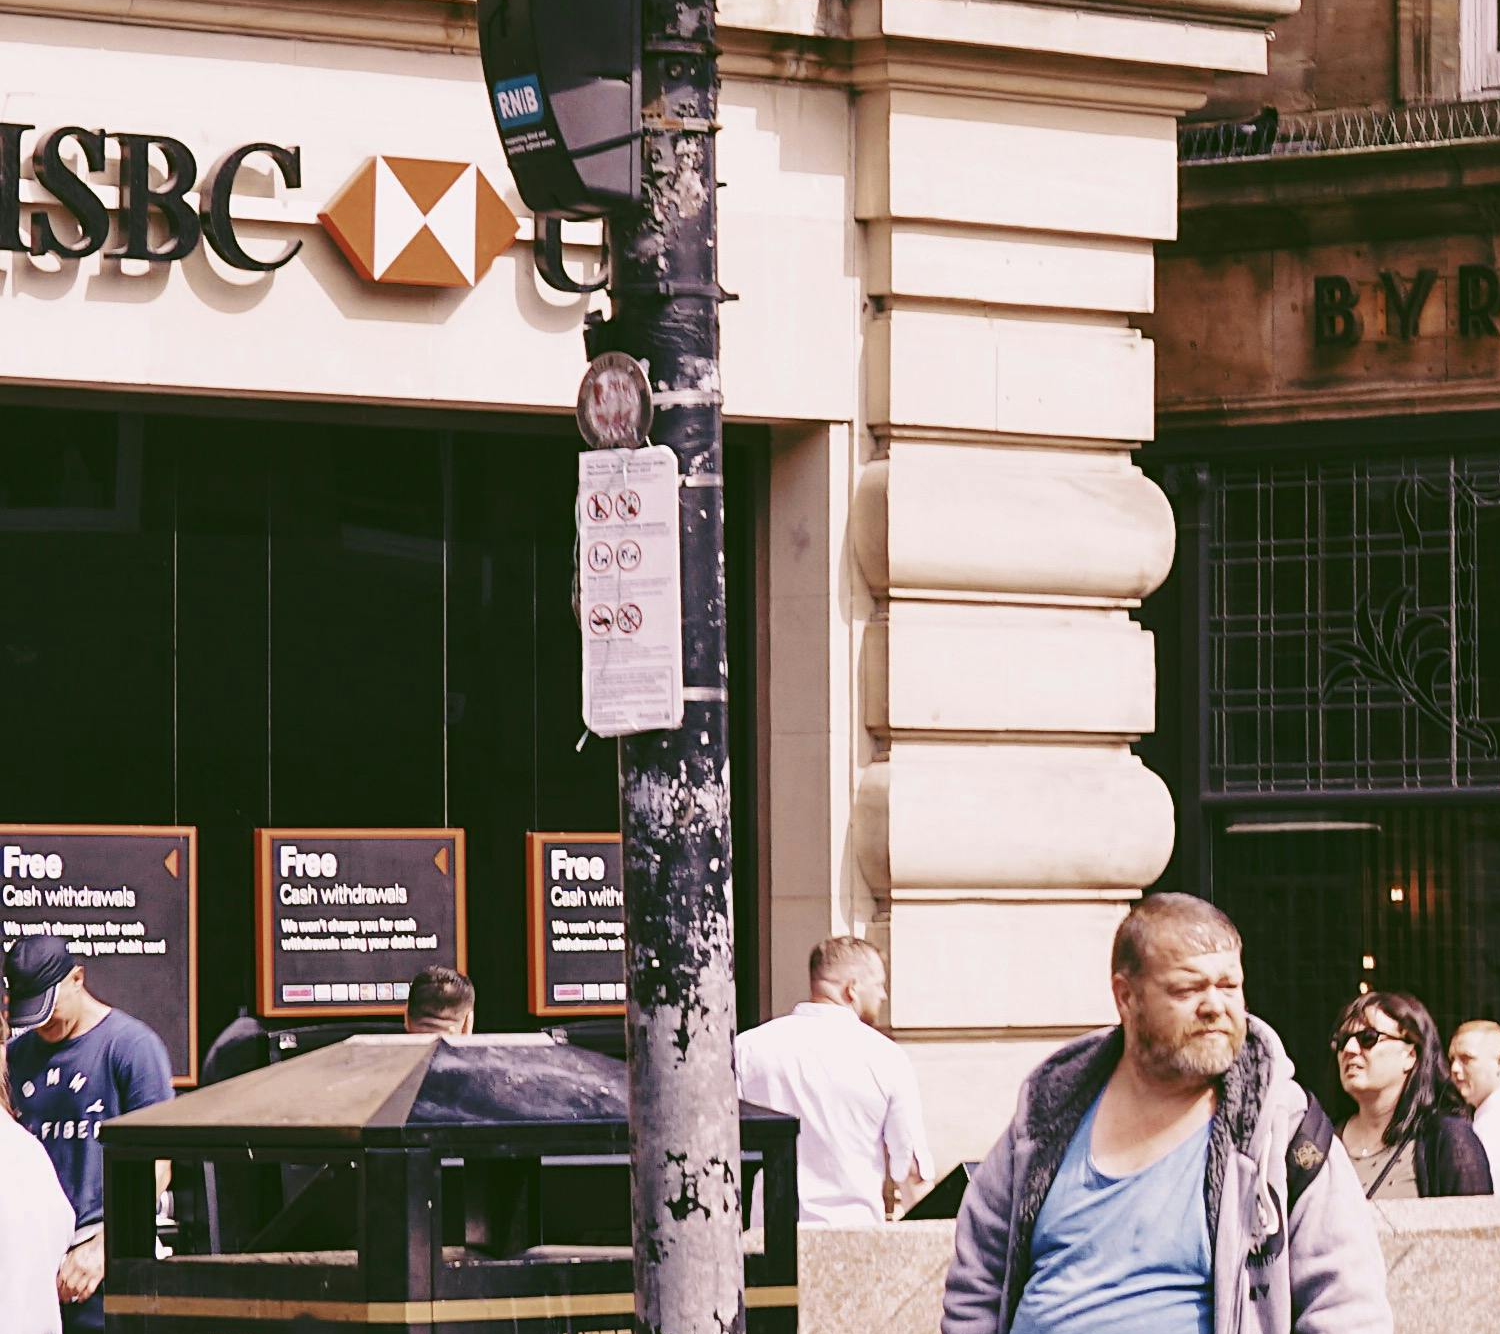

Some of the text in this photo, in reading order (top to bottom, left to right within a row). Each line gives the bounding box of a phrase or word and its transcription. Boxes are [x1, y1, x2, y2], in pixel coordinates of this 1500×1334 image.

[497, 85, 539, 119] RNIB
[3, 846, 63, 879] Free
[280, 846, 337, 878] Free
[551, 849, 605, 880] Free
[3, 885, 136, 908] Cash withdrawals
[280, 883, 407, 905] Cash withdrawals
[551, 886, 586, 907] Cash
